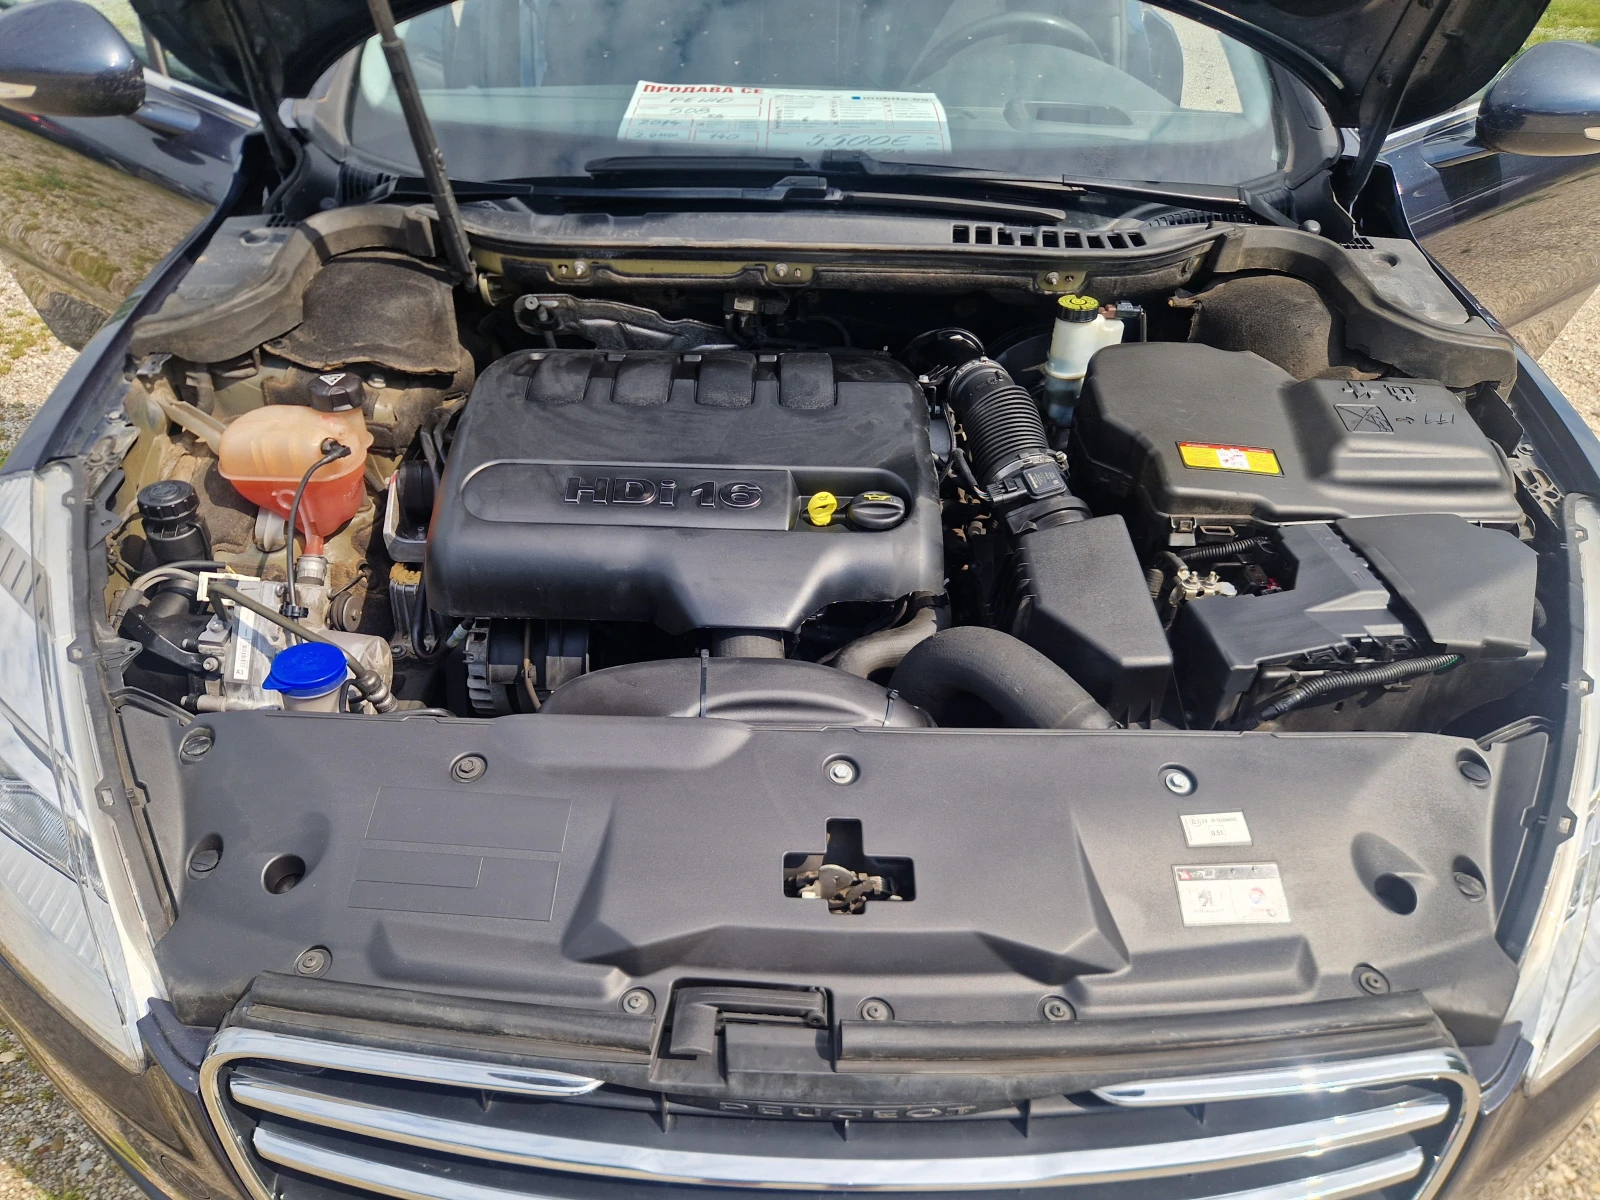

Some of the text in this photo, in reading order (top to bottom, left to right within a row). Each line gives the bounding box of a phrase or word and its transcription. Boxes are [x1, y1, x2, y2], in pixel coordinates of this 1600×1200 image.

[643, 84, 733, 93] ПРОДАВА
[564, 477, 763, 510] HDi 16
